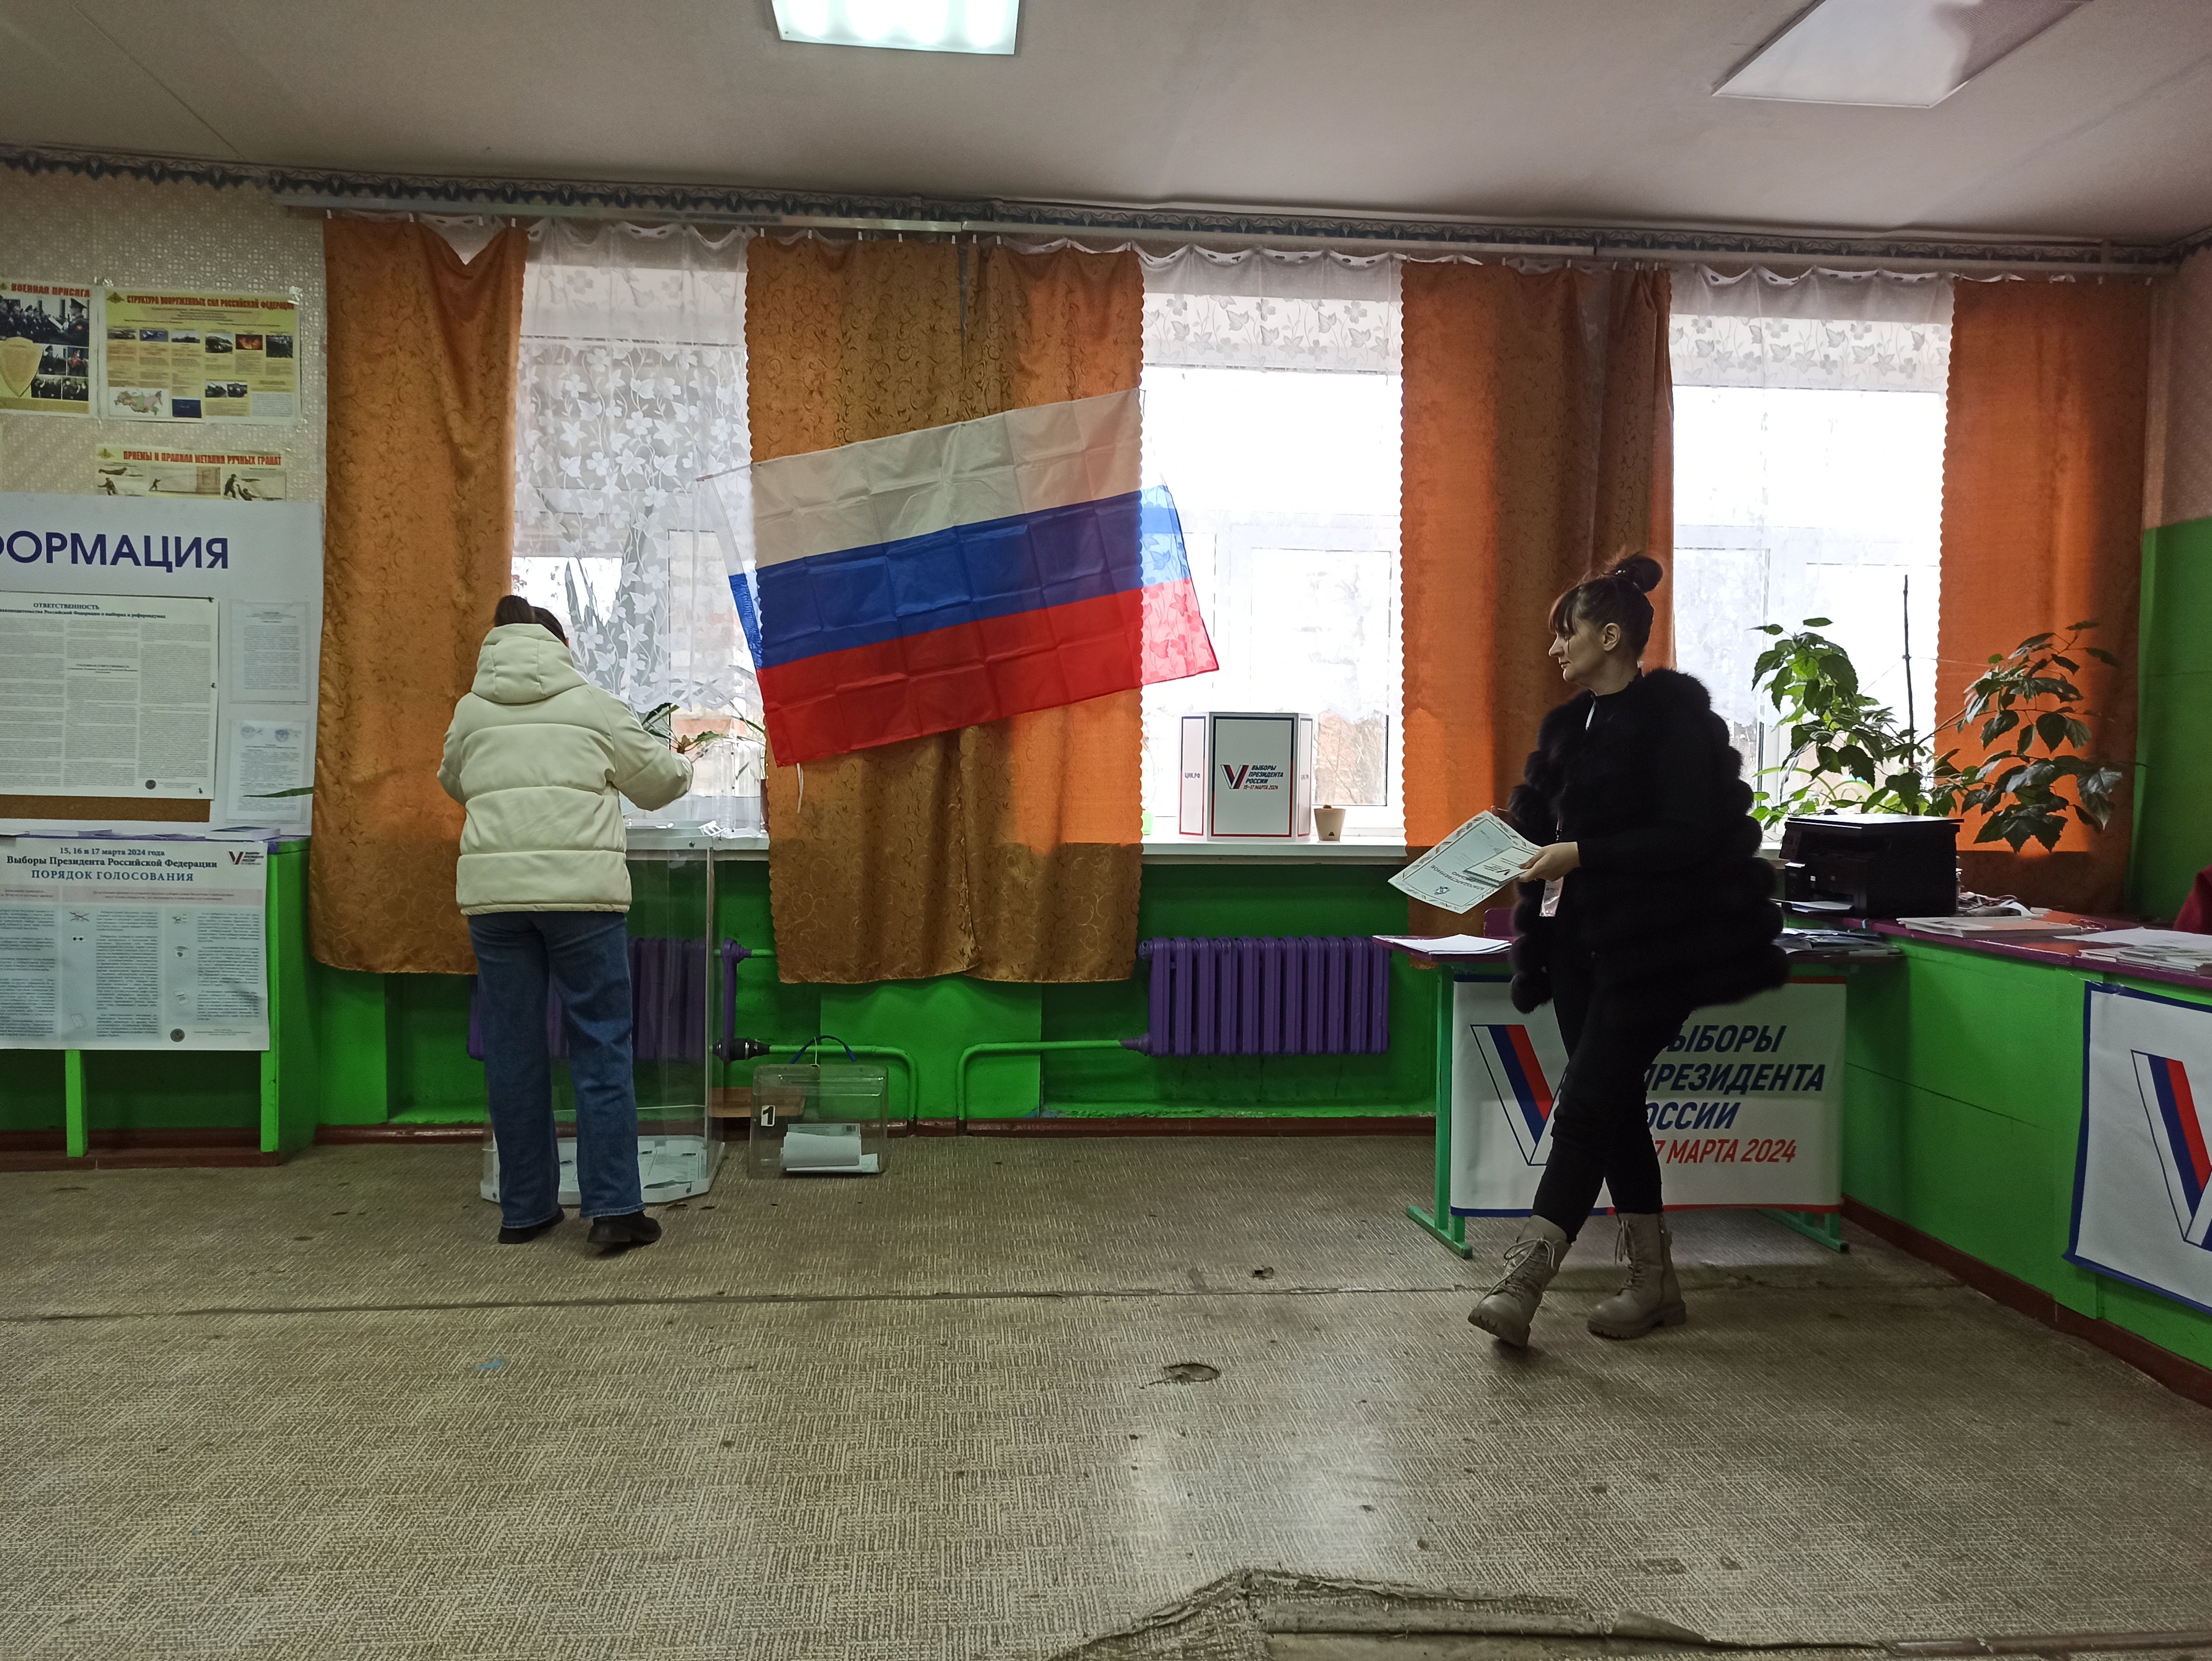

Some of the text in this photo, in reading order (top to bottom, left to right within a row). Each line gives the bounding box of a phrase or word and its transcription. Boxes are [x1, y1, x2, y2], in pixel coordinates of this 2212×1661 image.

[52, 287, 91, 298] ПРИСЯГА
[127, 295, 159, 304] СТРУКТУРА
[221, 298, 259, 309] РОССИЙСКОЙ
[123, 451, 282, 465] ПРИЕМЫ И ПРАВИЛА МЕТАНИЯ РУЧНЫХ ГРАНАТ
[0, 531, 229, 573] ОРМАЦИЯ
[7, 855, 218, 869] Выборы Президента Российской Федерации
[32, 870, 194, 882] ПОРЯДОК ГОЛОСОВАНИЯ
[1667, 1025, 1787, 1052] ЫБОРЫ
[763, 1107, 774, 1125] 1
[1646, 1102, 1741, 1130] ОССИИ
[1666, 1139, 1738, 1163] МАРТА
[1740, 1139, 1796, 1163] 2024
